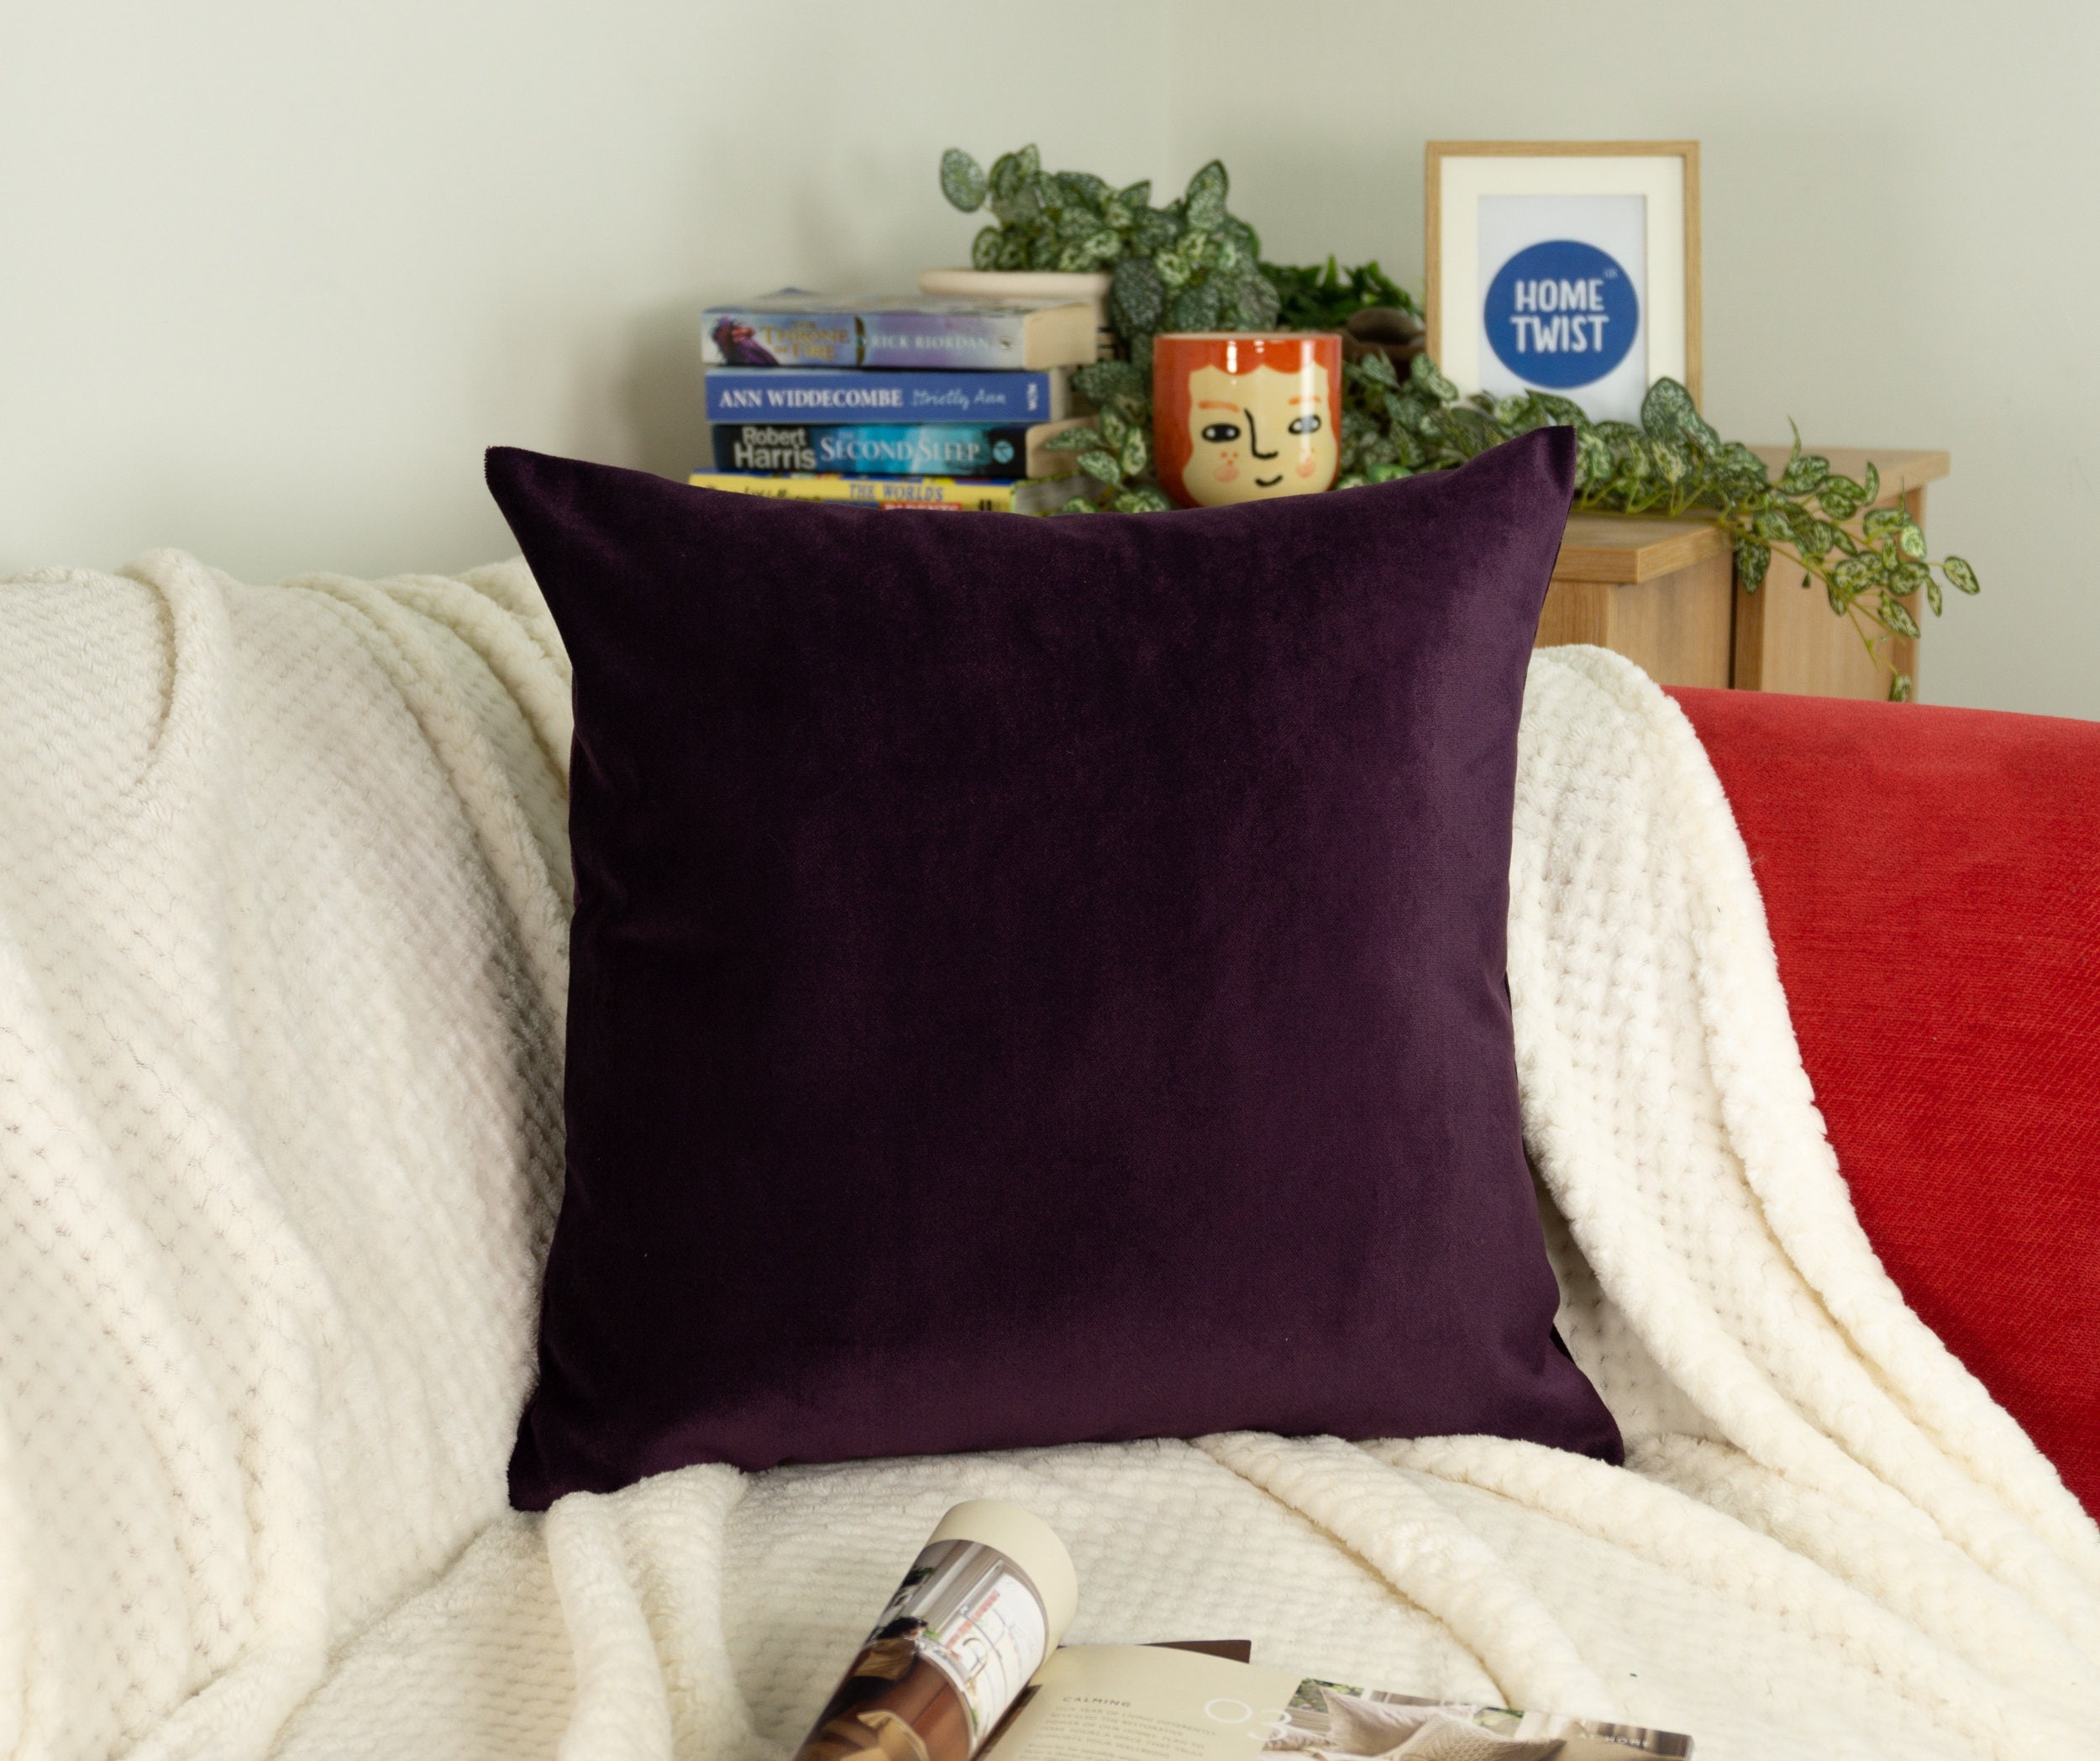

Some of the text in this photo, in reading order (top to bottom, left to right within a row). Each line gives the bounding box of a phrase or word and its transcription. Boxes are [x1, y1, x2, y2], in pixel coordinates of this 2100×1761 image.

[1515, 278, 1605, 313] HOME
[871, 335, 990, 350] RICK RIORDAN
[1509, 315, 1610, 354] TWIST
[719, 389, 904, 409] ANN WIDDECOMBE
[974, 388, 1007, 405] Ann
[742, 426, 806, 446] Robert
[733, 441, 817, 469] Harris
[820, 435, 981, 462] SECOND SLEEP
[849, 483, 876, 501] THE
[1062, 1696, 1131, 1707] CALMING
